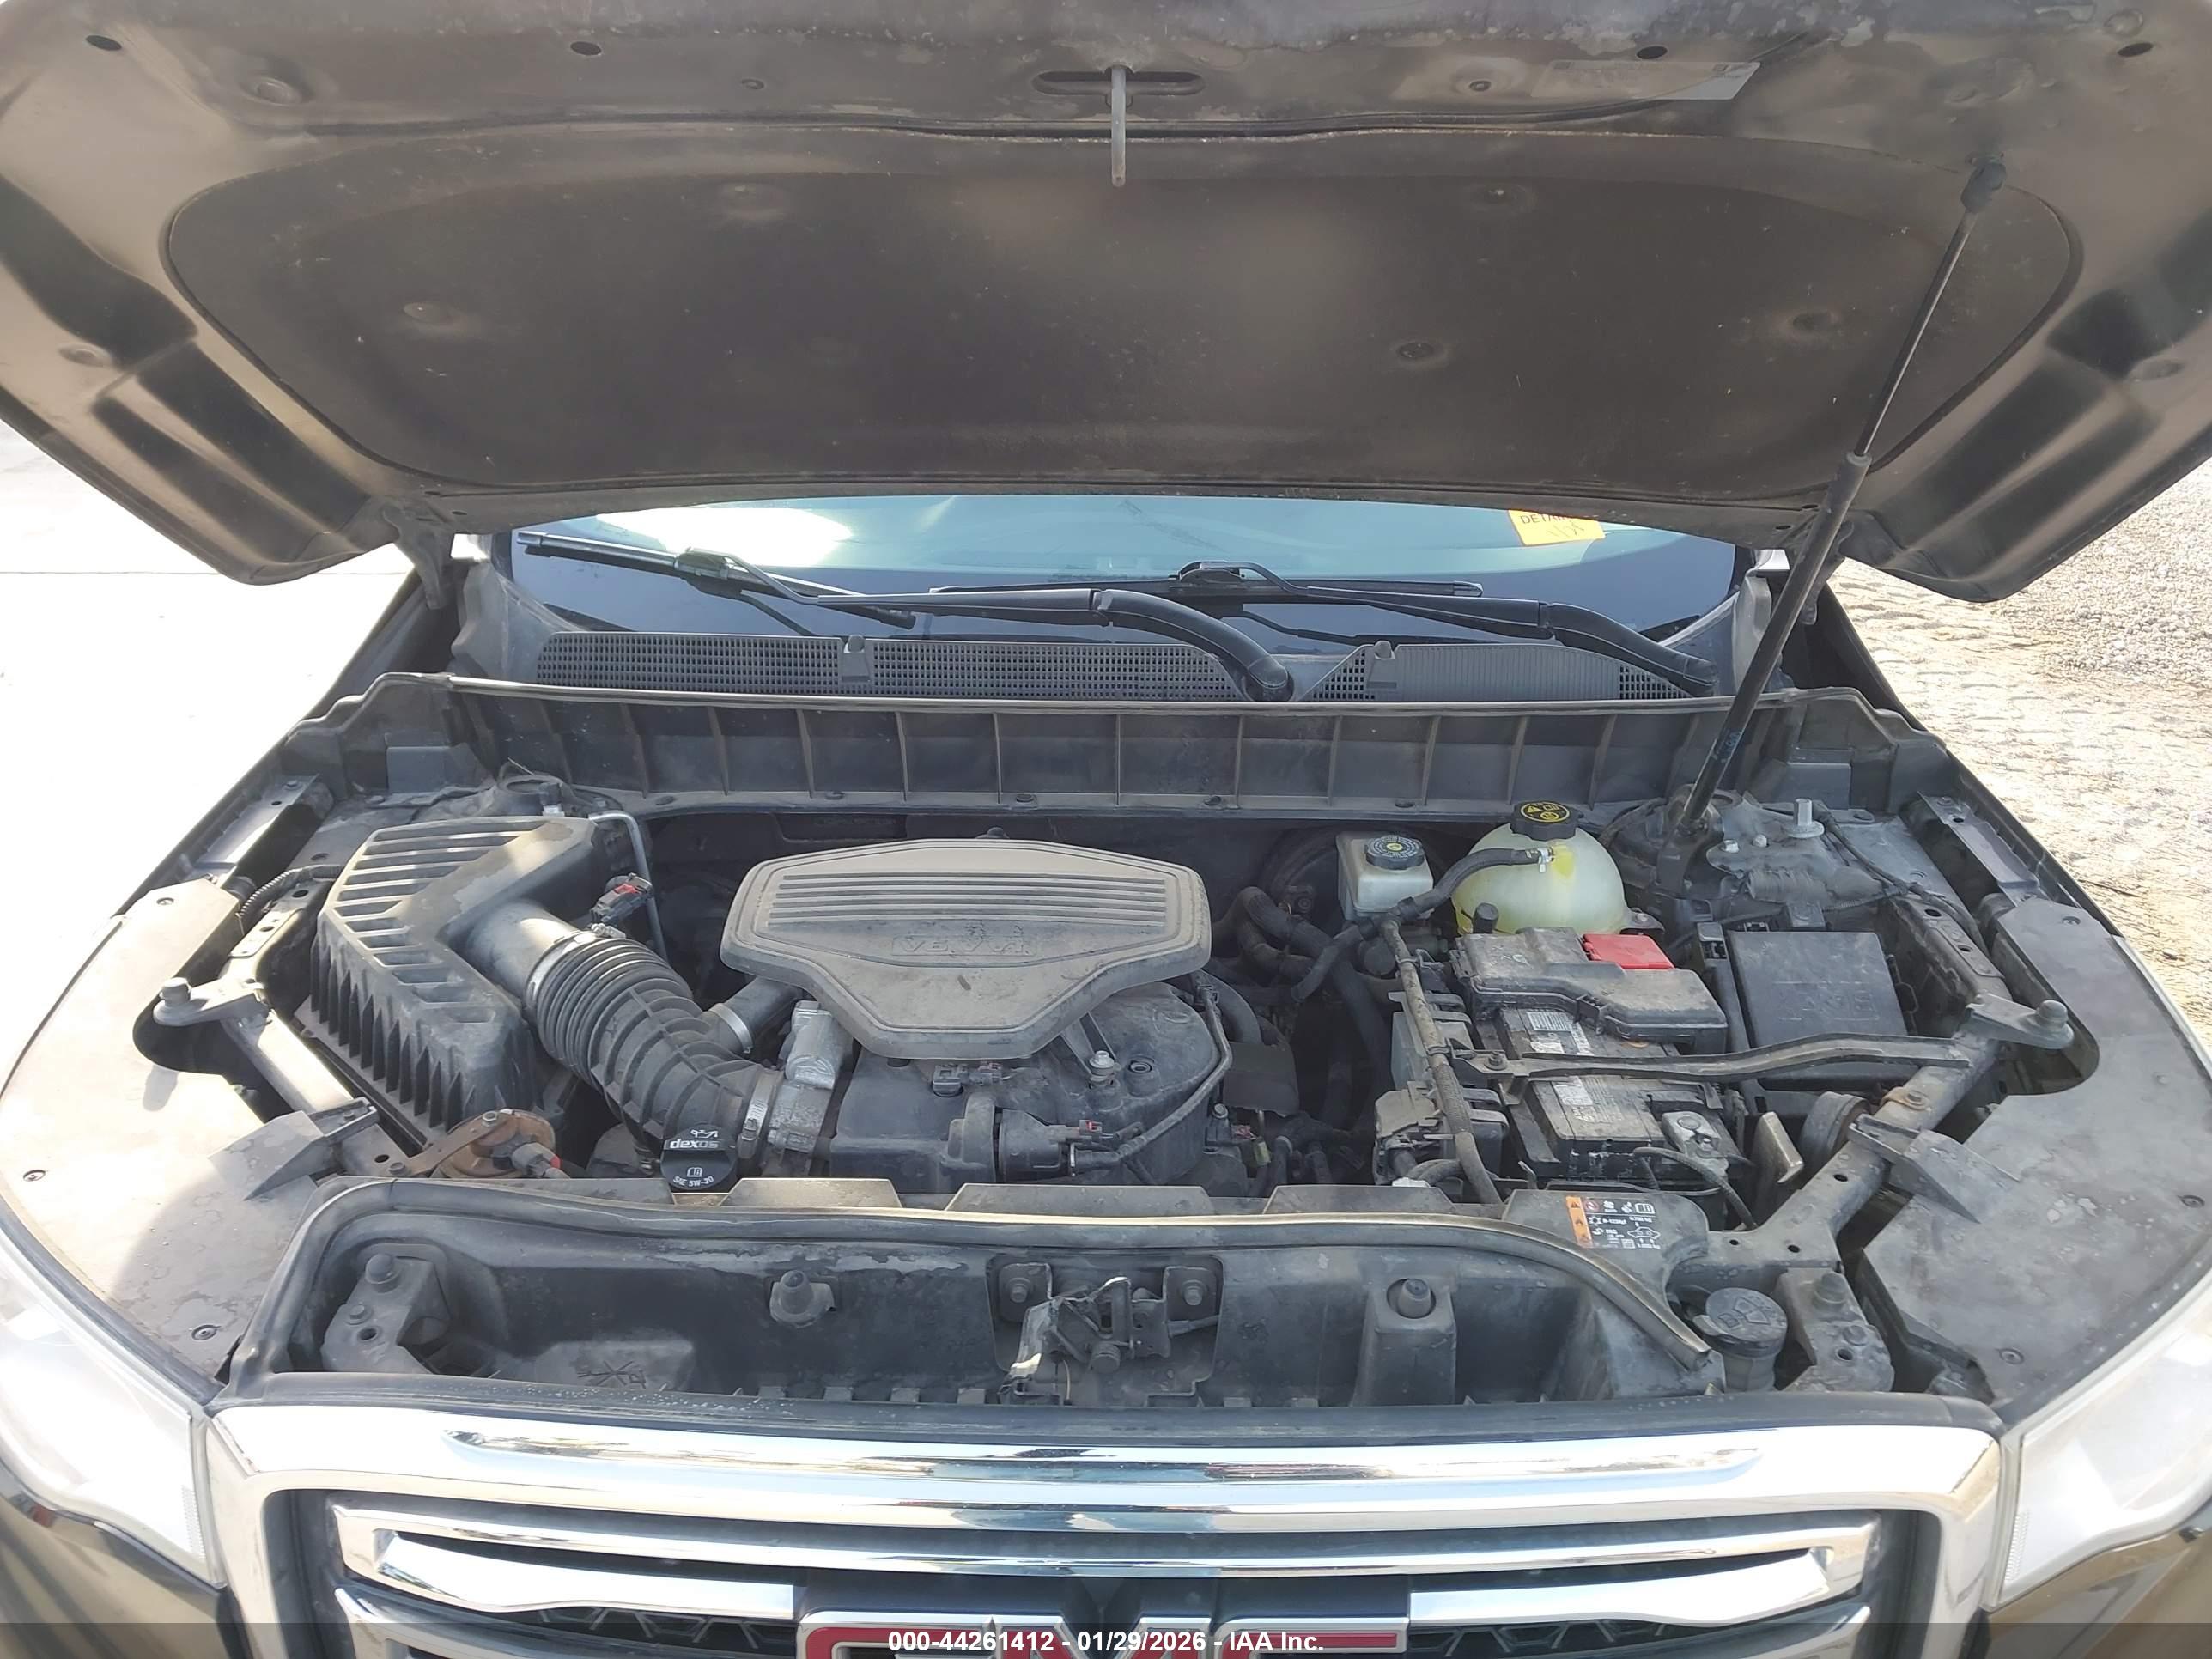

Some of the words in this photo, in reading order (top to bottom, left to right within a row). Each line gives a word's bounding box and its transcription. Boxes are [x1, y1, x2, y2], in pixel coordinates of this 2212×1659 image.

[670, 1138, 720, 1149] dexos
[672, 1176, 687, 1187] SAE
[688, 1176, 715, 1188] 5W-30
